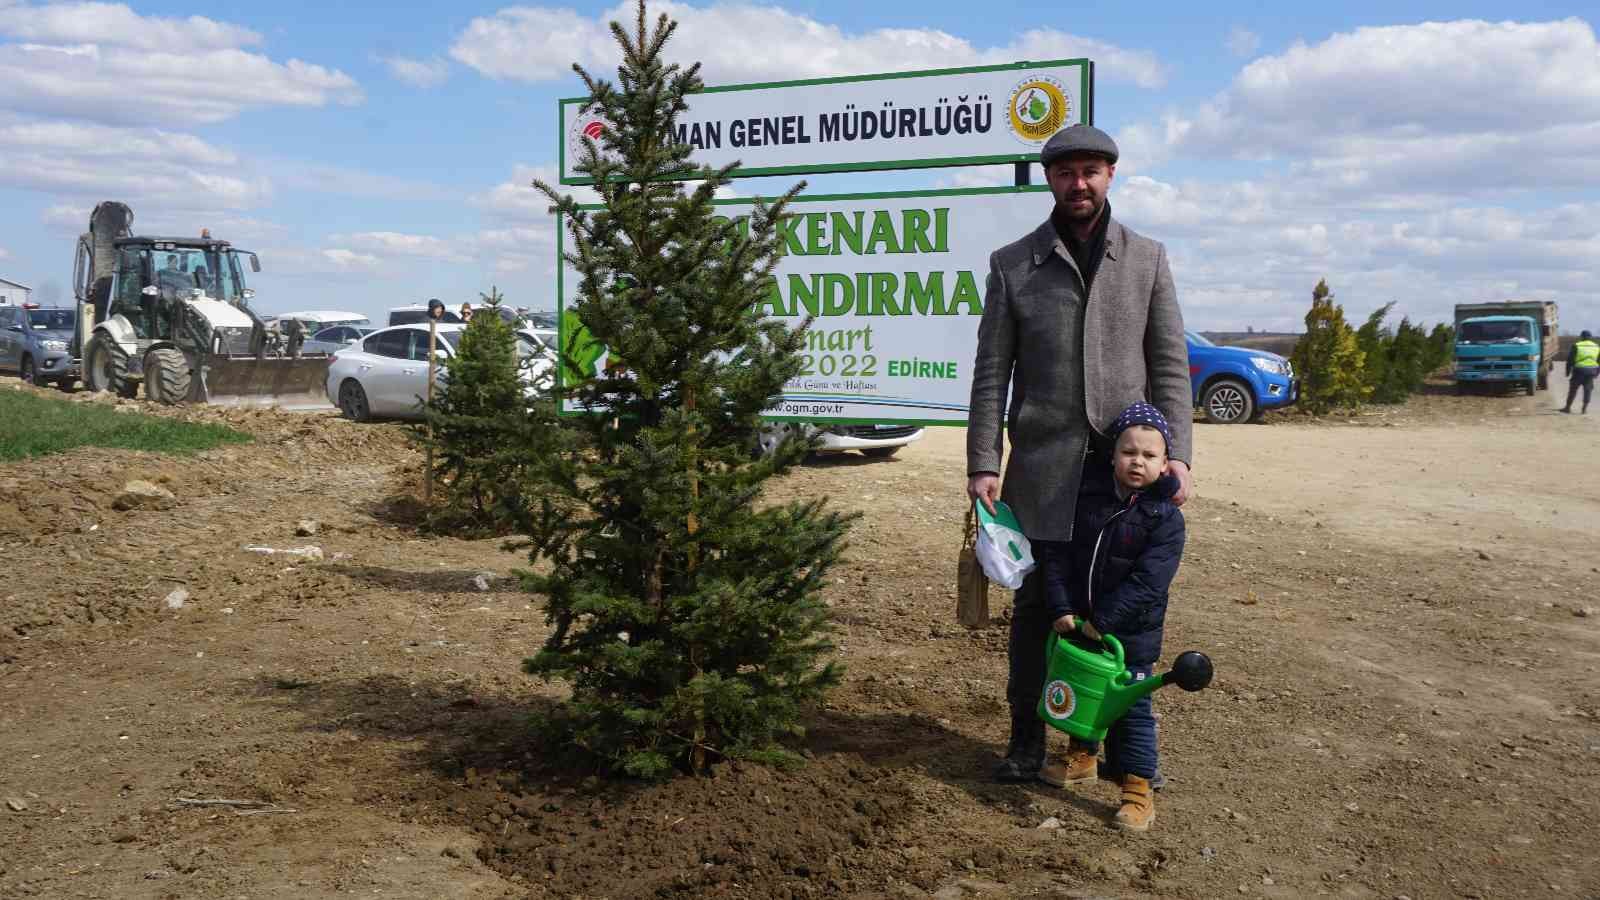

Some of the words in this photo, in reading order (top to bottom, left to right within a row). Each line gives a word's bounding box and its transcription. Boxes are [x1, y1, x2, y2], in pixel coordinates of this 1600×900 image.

[668, 121, 721, 150] MAN
[729, 115, 811, 148] GENEL
[818, 94, 993, 143] MÜDÜRLÜĞÜ
[774, 207, 951, 256] KENARI
[746, 270, 985, 317] ANDIRMA
[799, 322, 873, 352] mart
[799, 354, 878, 377] 2022
[887, 356, 958, 379] EDİRNE
